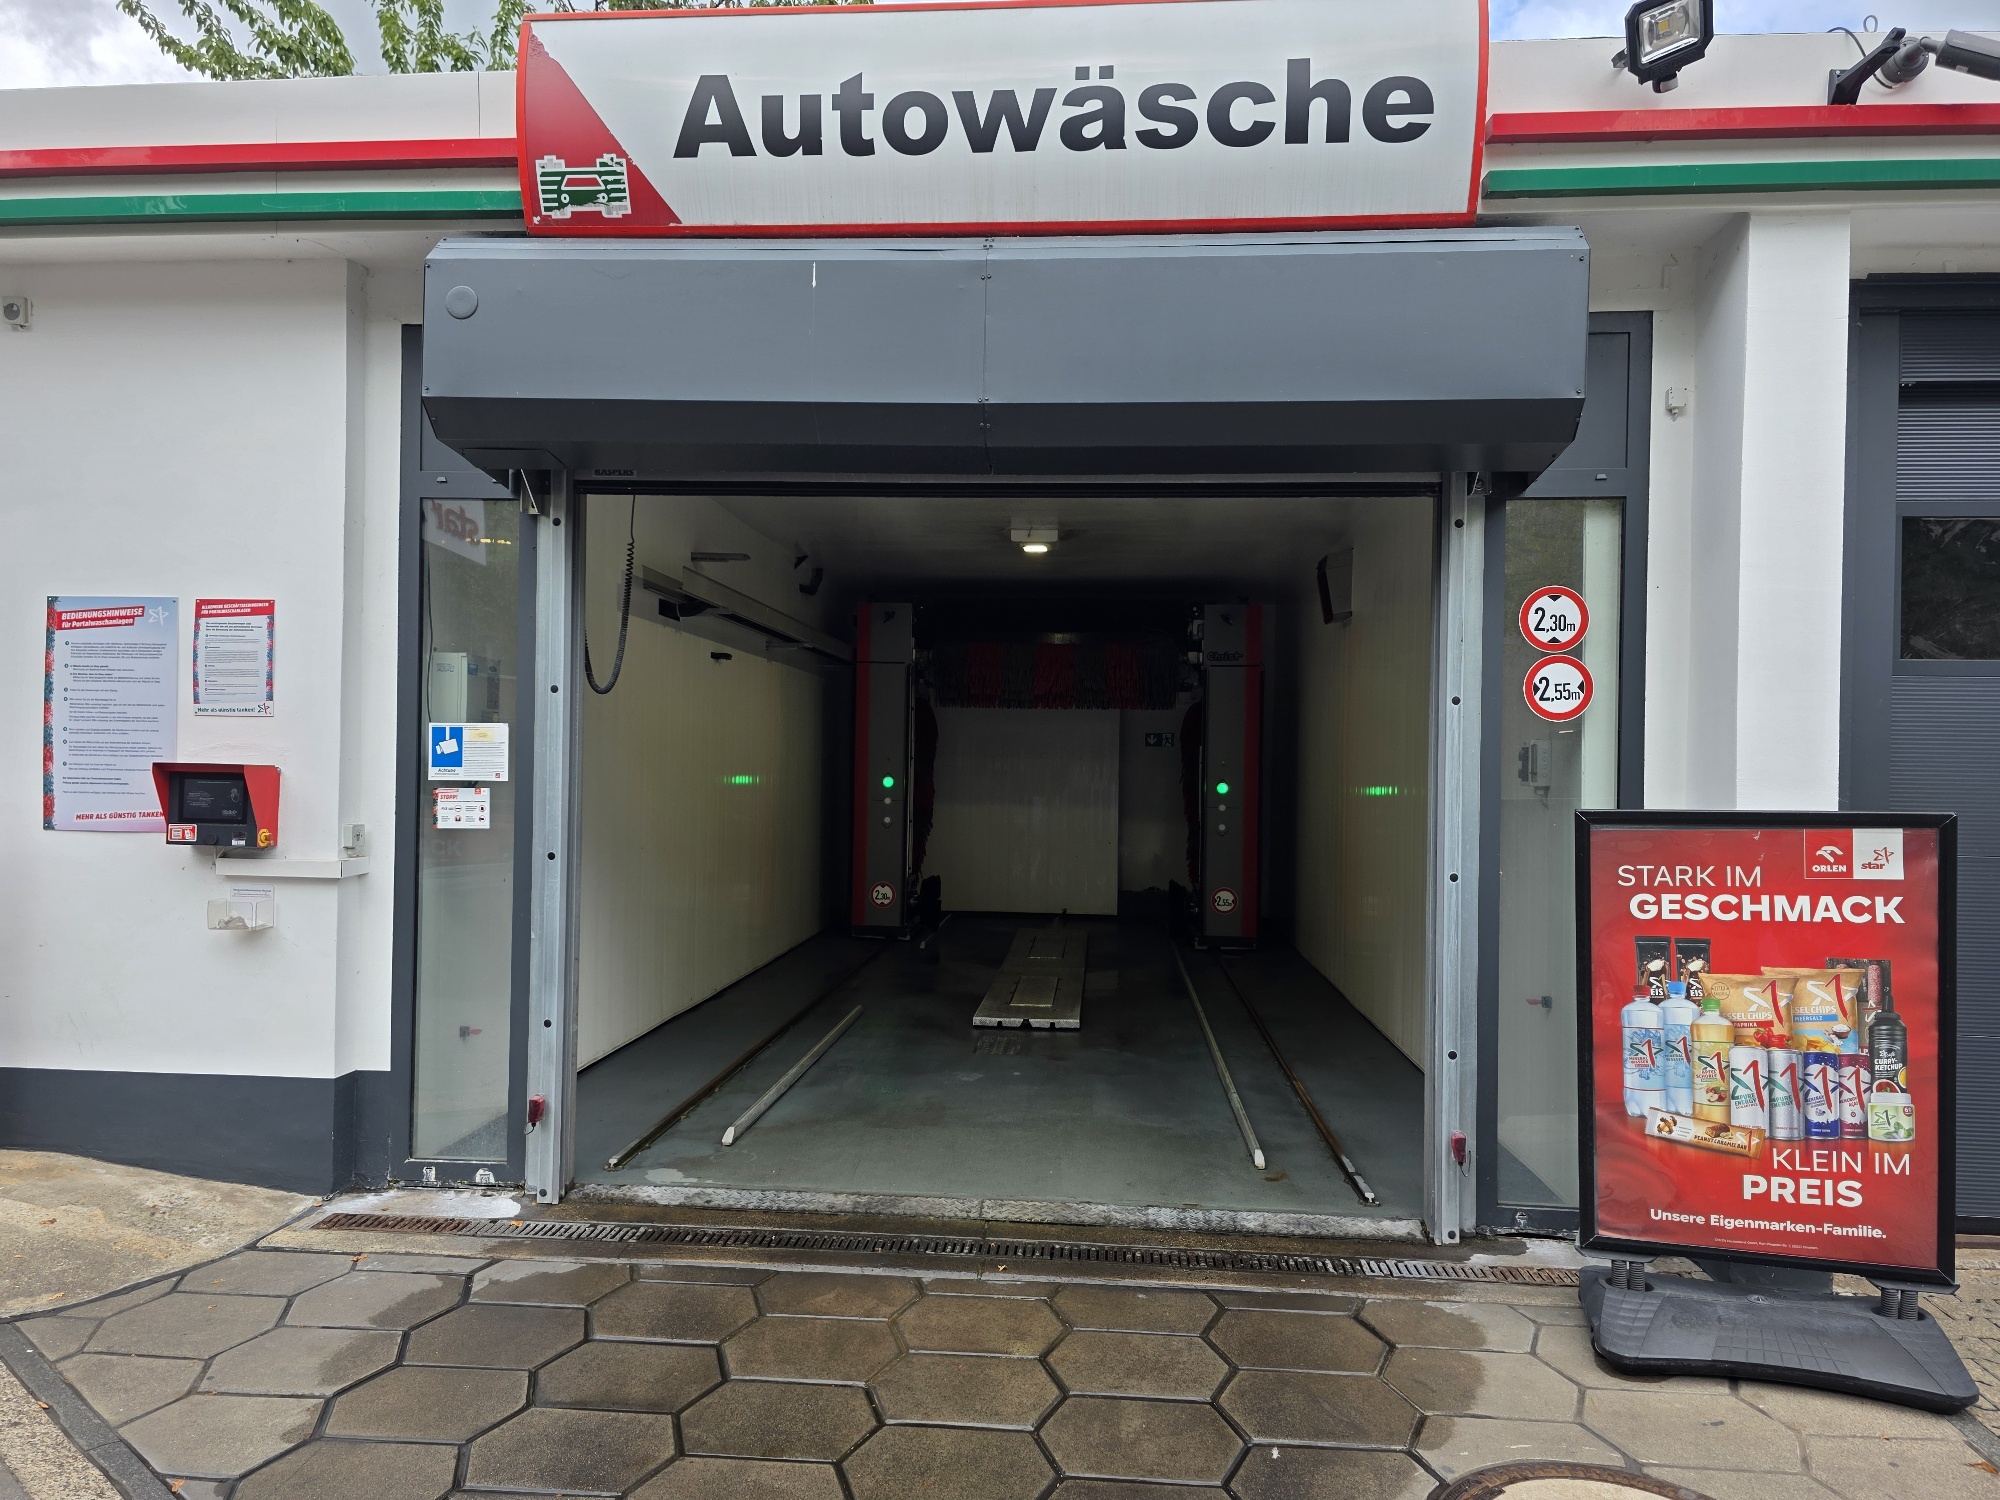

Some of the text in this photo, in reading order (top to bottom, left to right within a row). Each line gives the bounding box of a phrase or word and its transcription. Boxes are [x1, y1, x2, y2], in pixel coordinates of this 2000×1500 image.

[673, 58, 1435, 159] Autowäsche
[61, 607, 144, 620] BEDIENUNGSHINWEISE
[61, 618, 134, 628] für Portalwaschanlagen
[95, 812, 108, 820] ALS
[108, 811, 137, 819] GÜNSTIG
[1812, 864, 1847, 873] ORLEN
[1861, 861, 1886, 870] star
[1617, 865, 1761, 887] STARK IM
[1629, 893, 1906, 924] GESCHMACK
[1650, 988, 1664, 996] EIS
[1690, 989, 1703, 997] EIS
[1811, 1005, 1837, 1014] CHIPS
[1747, 1012, 1773, 1020] CHIPS
[1874, 1063, 1903, 1071] KETCHUP
[1734, 1098, 1757, 1106] ENERGY
[1774, 1094, 1792, 1102] PURE
[1771, 1100, 1793, 1108] ENERGY
[1772, 1148, 1910, 1176] KLEIN IM
[1742, 1174, 1863, 1208] PREIS
[1650, 1208, 1887, 1239] Unsere Eigenmarken-Familie.
